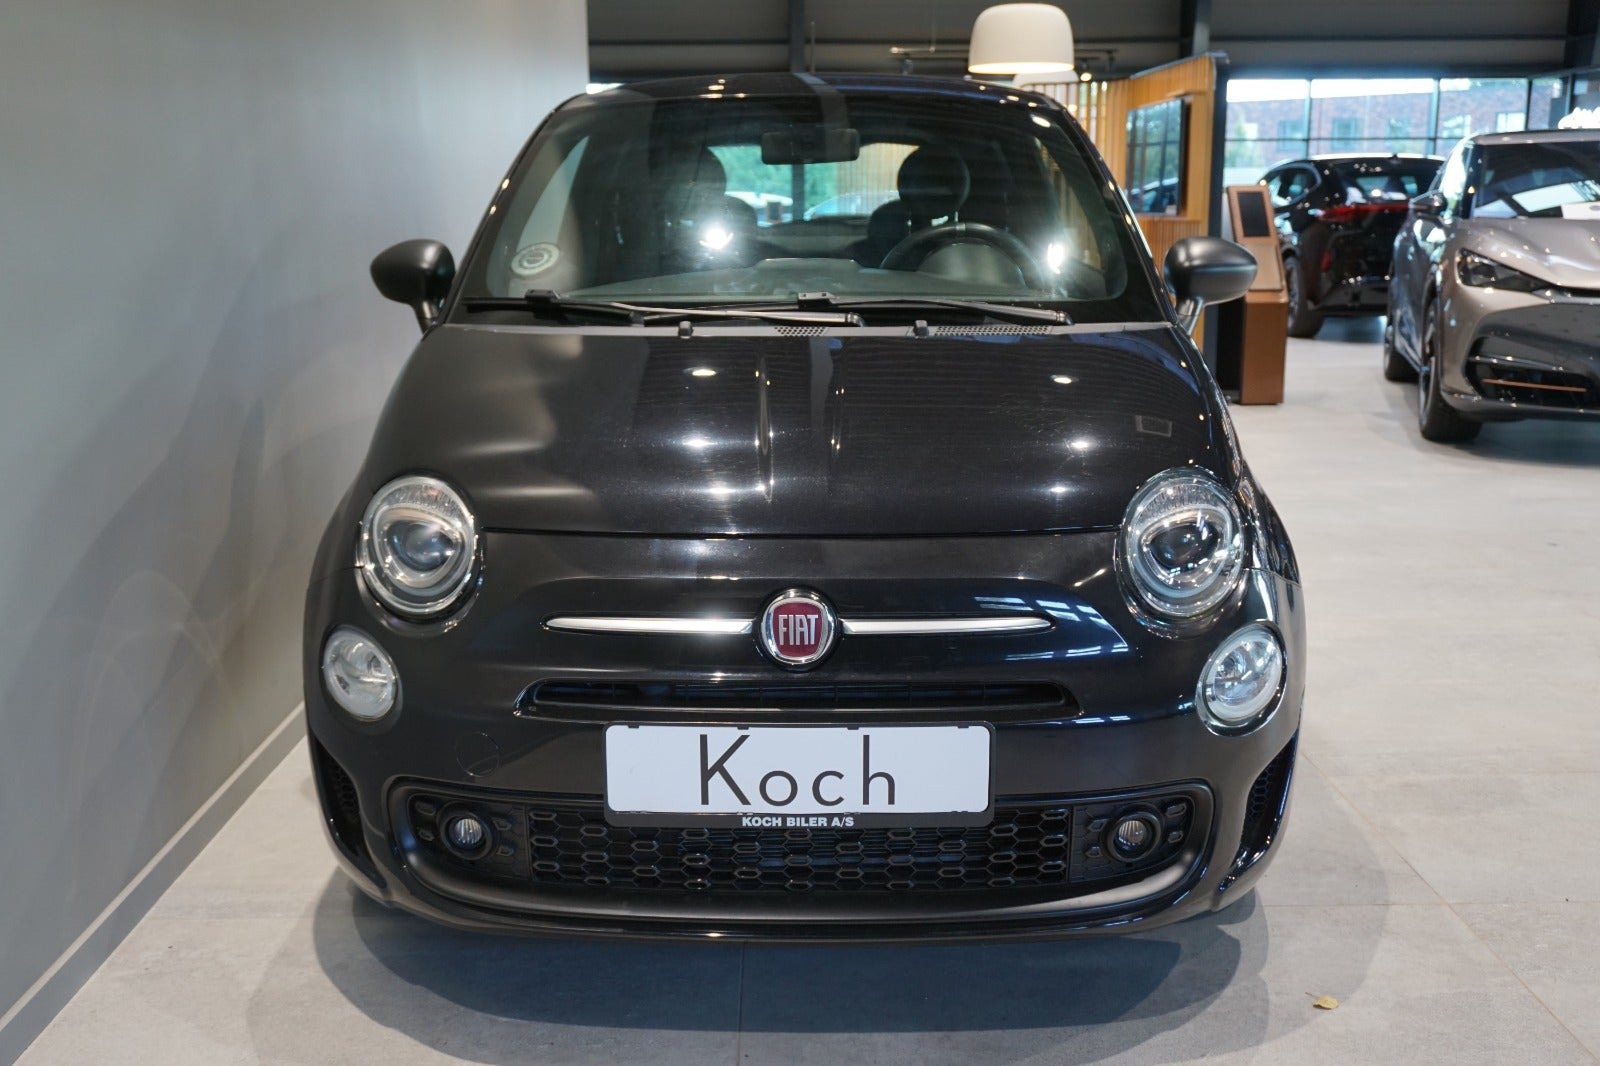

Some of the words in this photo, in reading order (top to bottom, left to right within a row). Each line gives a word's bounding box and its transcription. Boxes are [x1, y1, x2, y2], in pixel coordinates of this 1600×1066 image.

[778, 614, 819, 646] FIAT
[699, 734, 896, 806] Koch
[742, 816, 782, 827] KOCH
[786, 816, 828, 827] BILER
[830, 816, 855, 828] A/S
